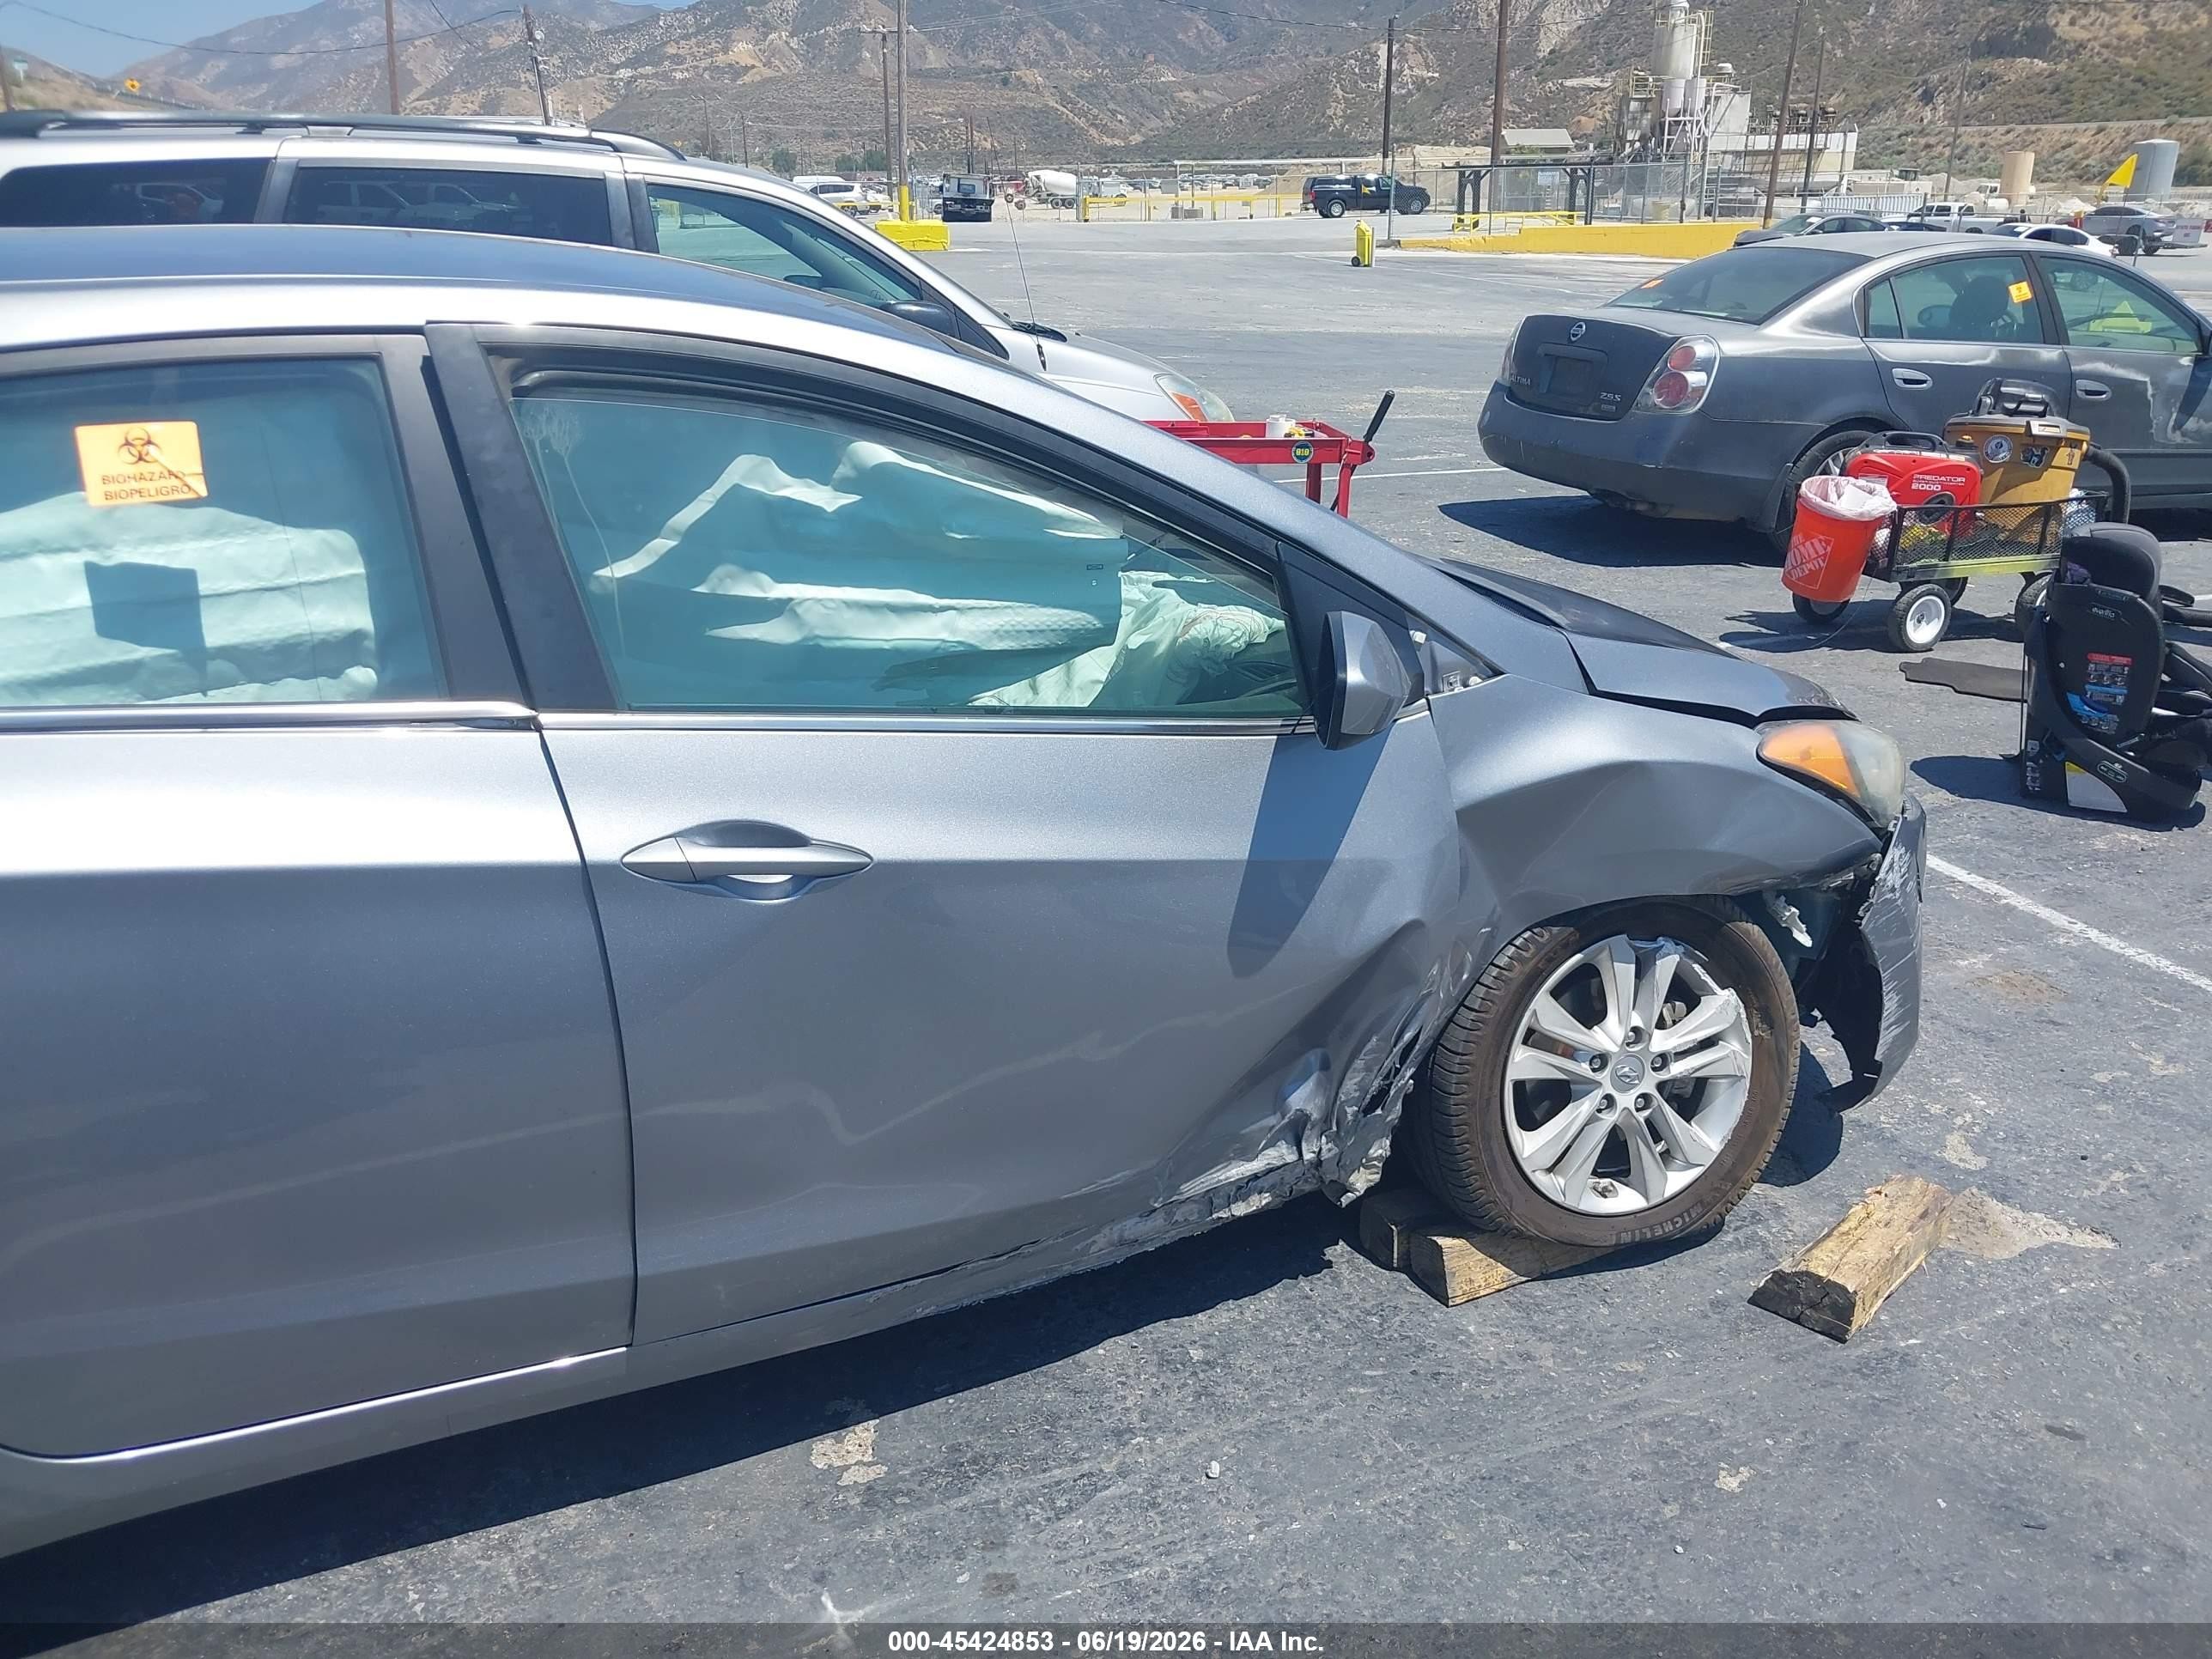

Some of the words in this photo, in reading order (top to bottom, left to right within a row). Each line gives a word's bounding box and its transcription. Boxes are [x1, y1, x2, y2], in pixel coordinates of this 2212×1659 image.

[1510, 373, 1531, 386] ALTIMA
[1912, 474, 1966, 483] PREDATOR
[104, 484, 191, 501] BIOPELIGRO
[1911, 483, 1942, 491] 2000
[1791, 556, 1826, 580] DEPOT
[1620, 1201, 1705, 1244] MICHELIN
